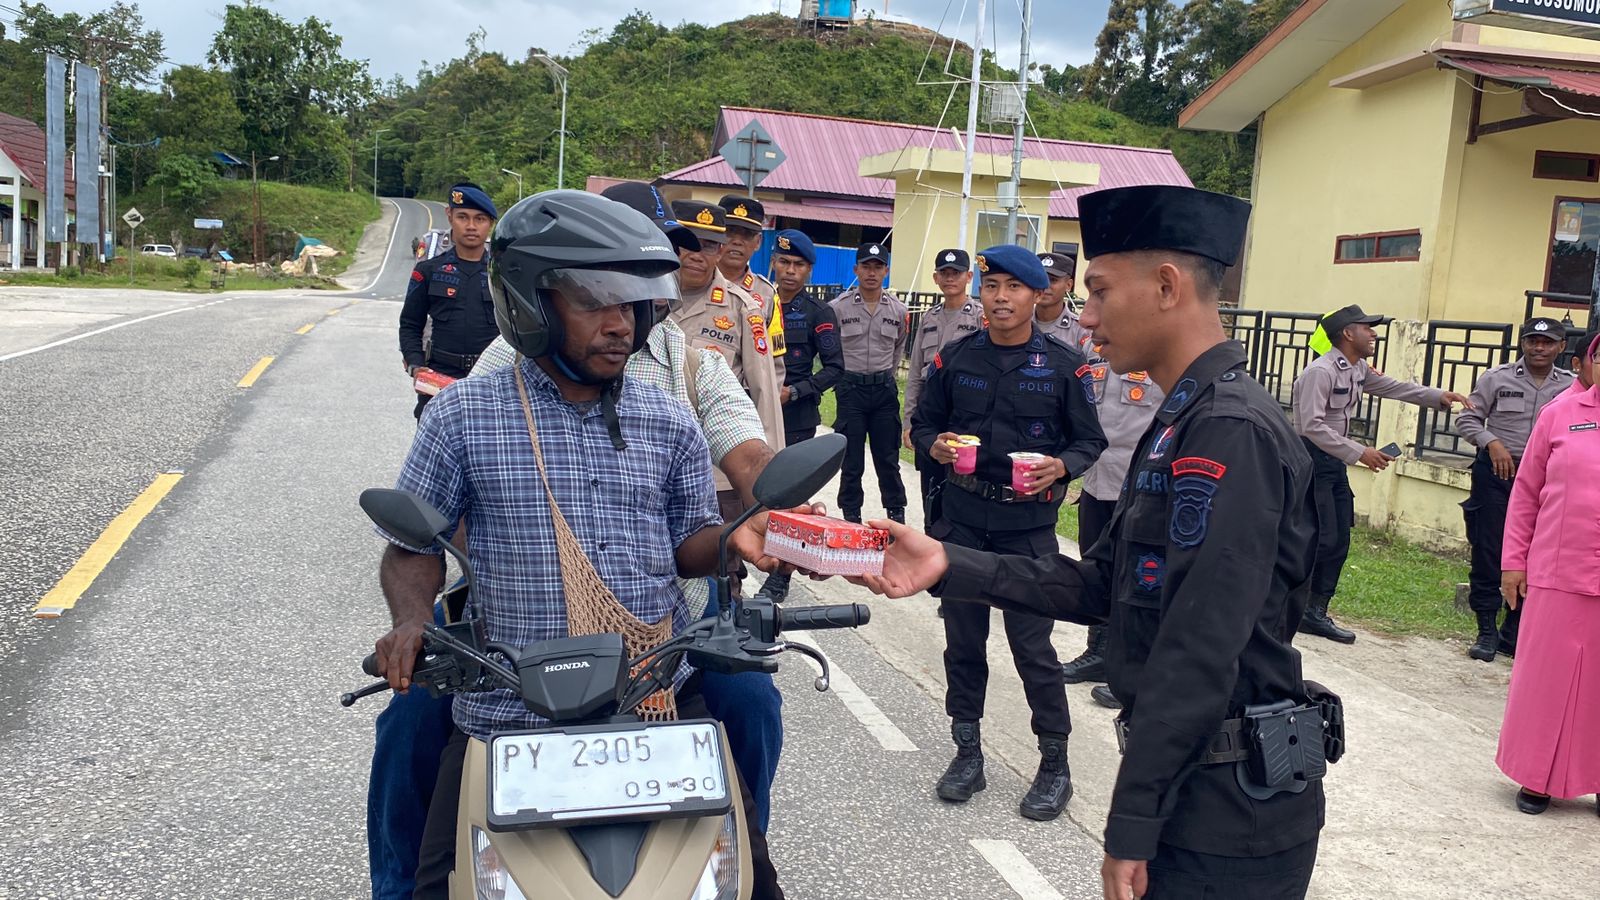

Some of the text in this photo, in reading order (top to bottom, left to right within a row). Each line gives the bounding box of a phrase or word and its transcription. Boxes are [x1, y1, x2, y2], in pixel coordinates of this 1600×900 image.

[701, 327, 734, 344] POLRI
[958, 375, 988, 391] FAHRI
[1019, 382, 1054, 393] POLRI
[544, 660, 591, 673] HONDA
[503, 730, 715, 772] PY 2305 M
[624, 779, 662, 798] 09
